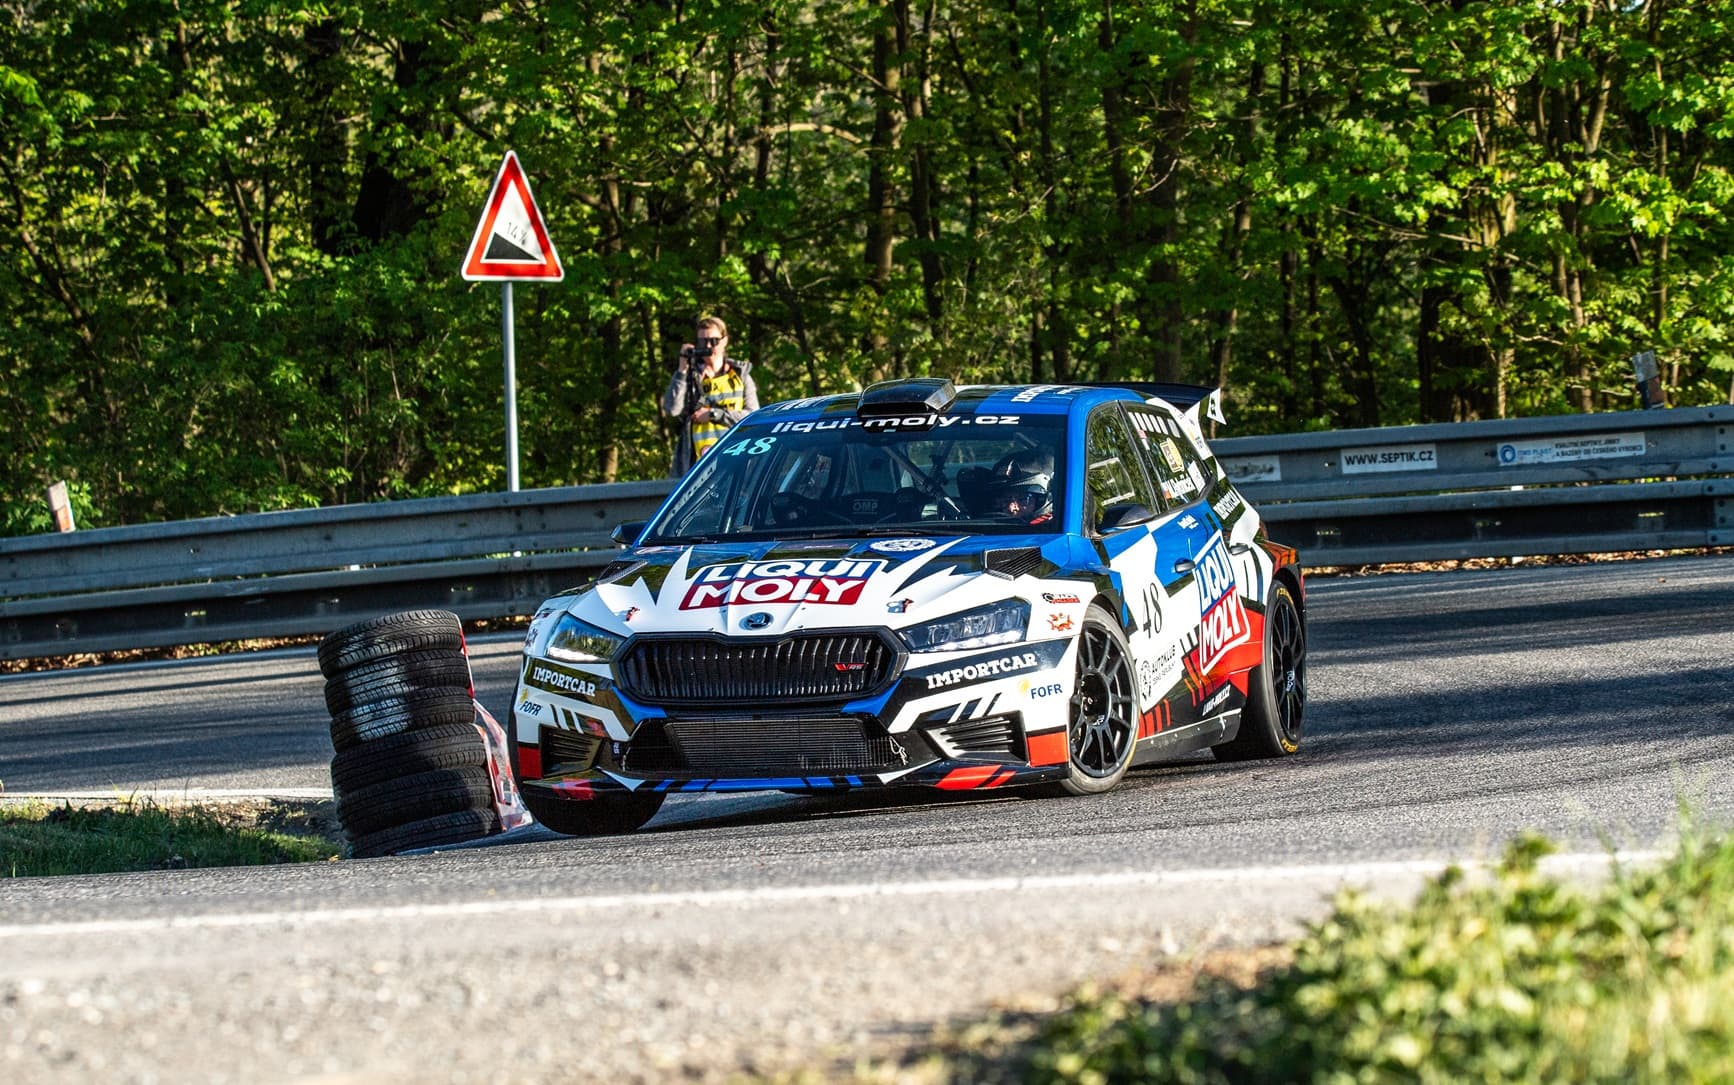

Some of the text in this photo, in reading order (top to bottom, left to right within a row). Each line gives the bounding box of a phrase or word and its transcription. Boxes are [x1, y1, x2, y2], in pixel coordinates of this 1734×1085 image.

[771, 413, 1021, 433] liqui-moly.cz
[722, 436, 777, 456] 48
[1345, 450, 1434, 466] WWW.SEPTIK.CZ
[852, 501, 879, 511] OMP
[702, 560, 878, 582] LIQUI
[1196, 543, 1234, 613] LIQUI
[688, 577, 859, 607] MOLY
[1142, 582, 1162, 639] 48
[1202, 589, 1241, 664] MOLY
[533, 666, 596, 697] IMPORTCAR
[926, 652, 1038, 690] IMPORTCAR
[1030, 683, 1063, 700] FOFR
[519, 700, 542, 716] FOFR
